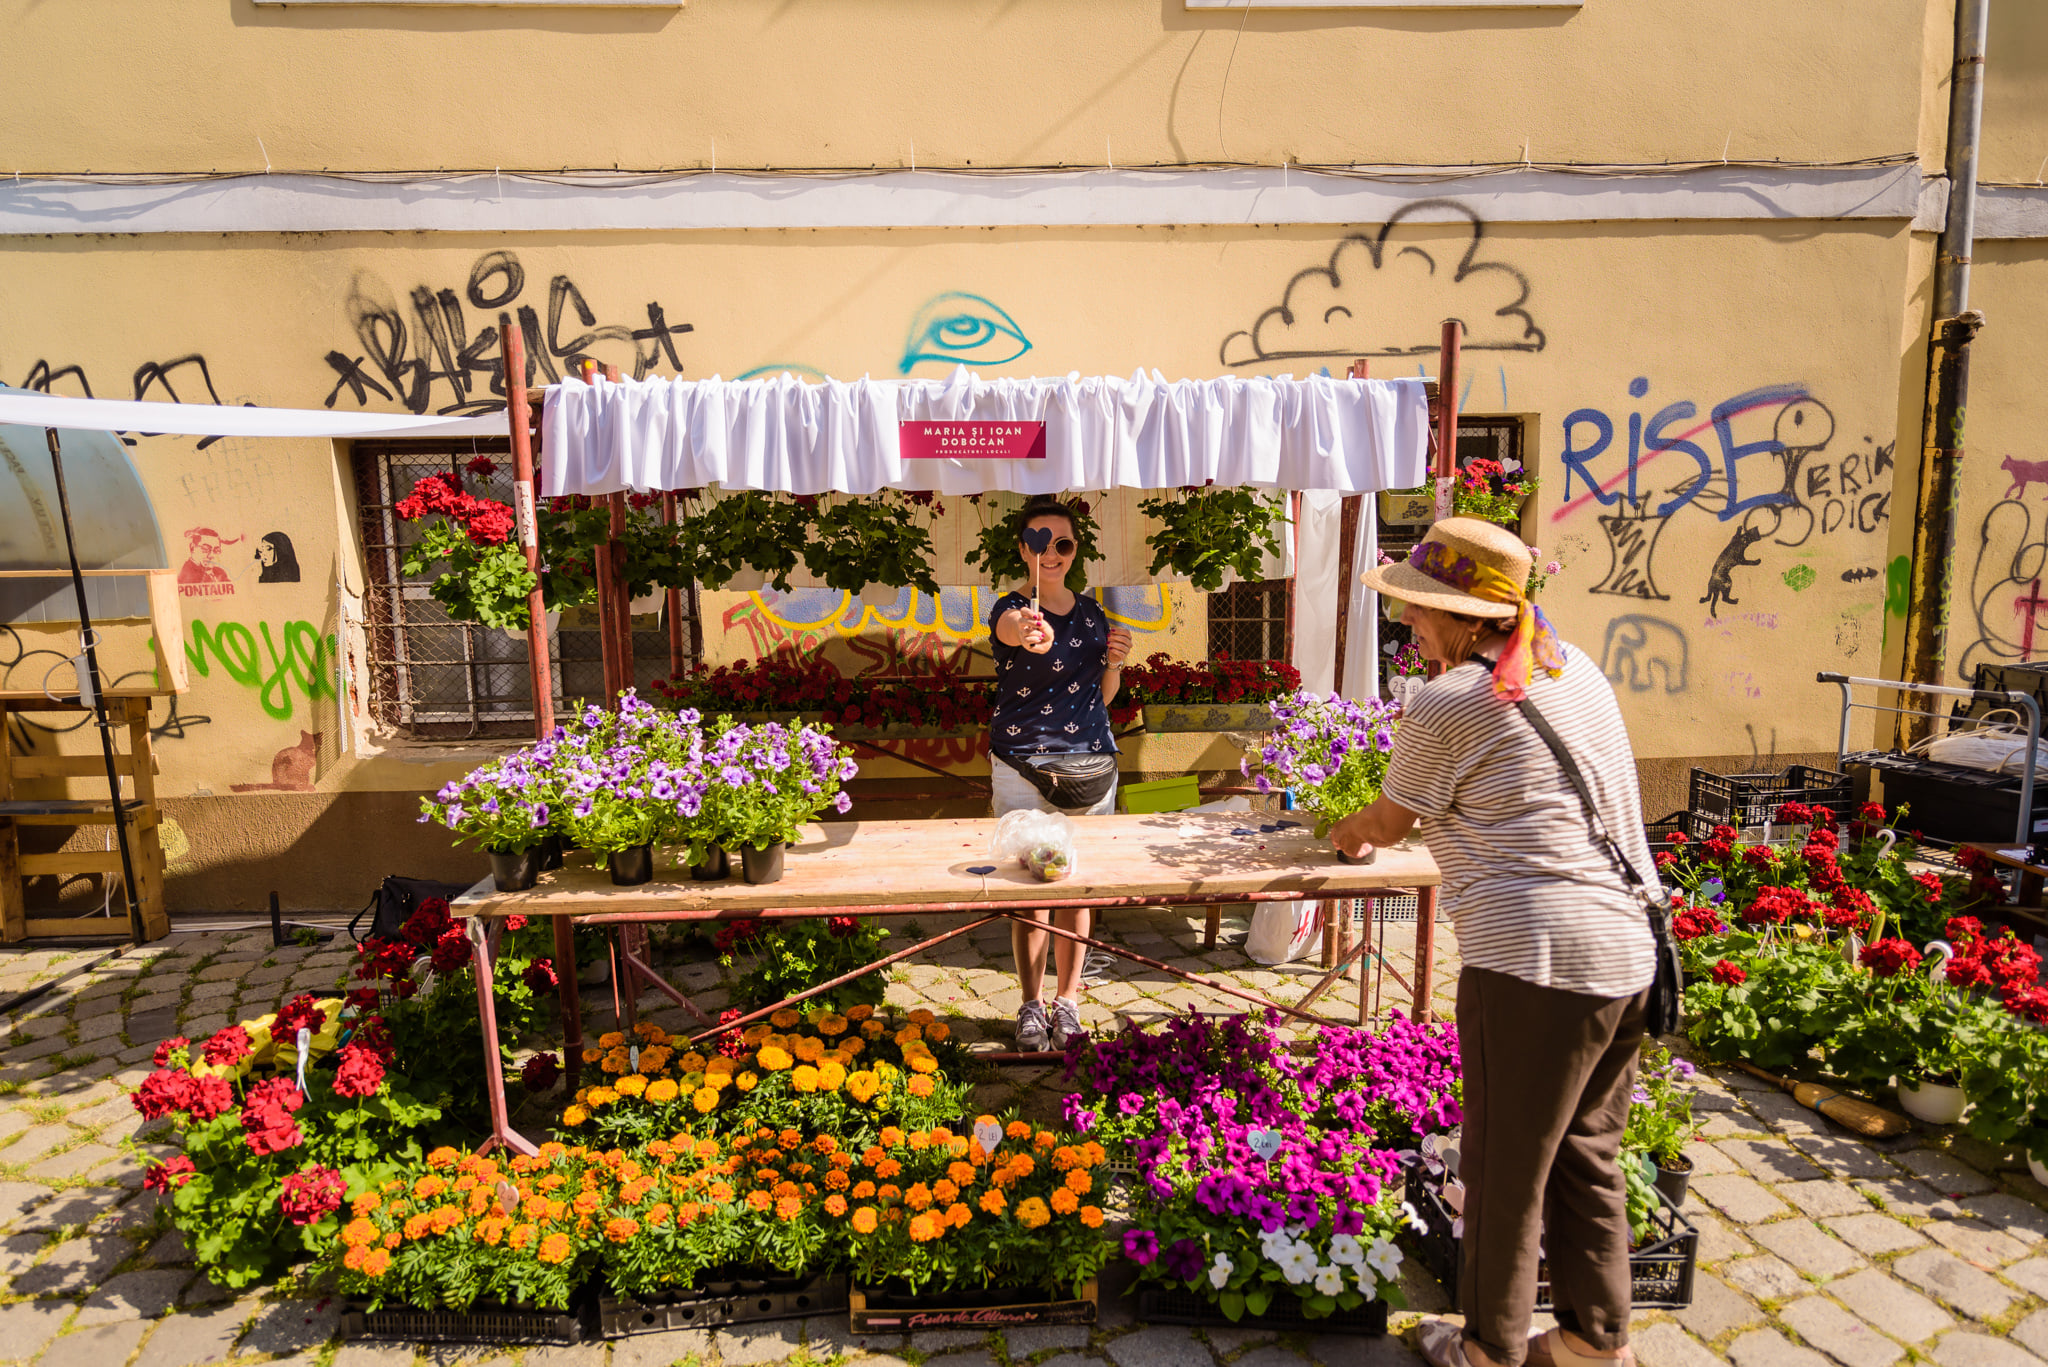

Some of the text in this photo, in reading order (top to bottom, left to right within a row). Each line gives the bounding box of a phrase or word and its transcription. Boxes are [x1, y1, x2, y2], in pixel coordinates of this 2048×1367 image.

[923, 427, 965, 436] MARIA
[990, 427, 1022, 436] IOAN
[941, 437, 1005, 446] DOBOCAN
[978, 1128, 985, 1140] 2
[1254, 1137, 1260, 1148] 2
